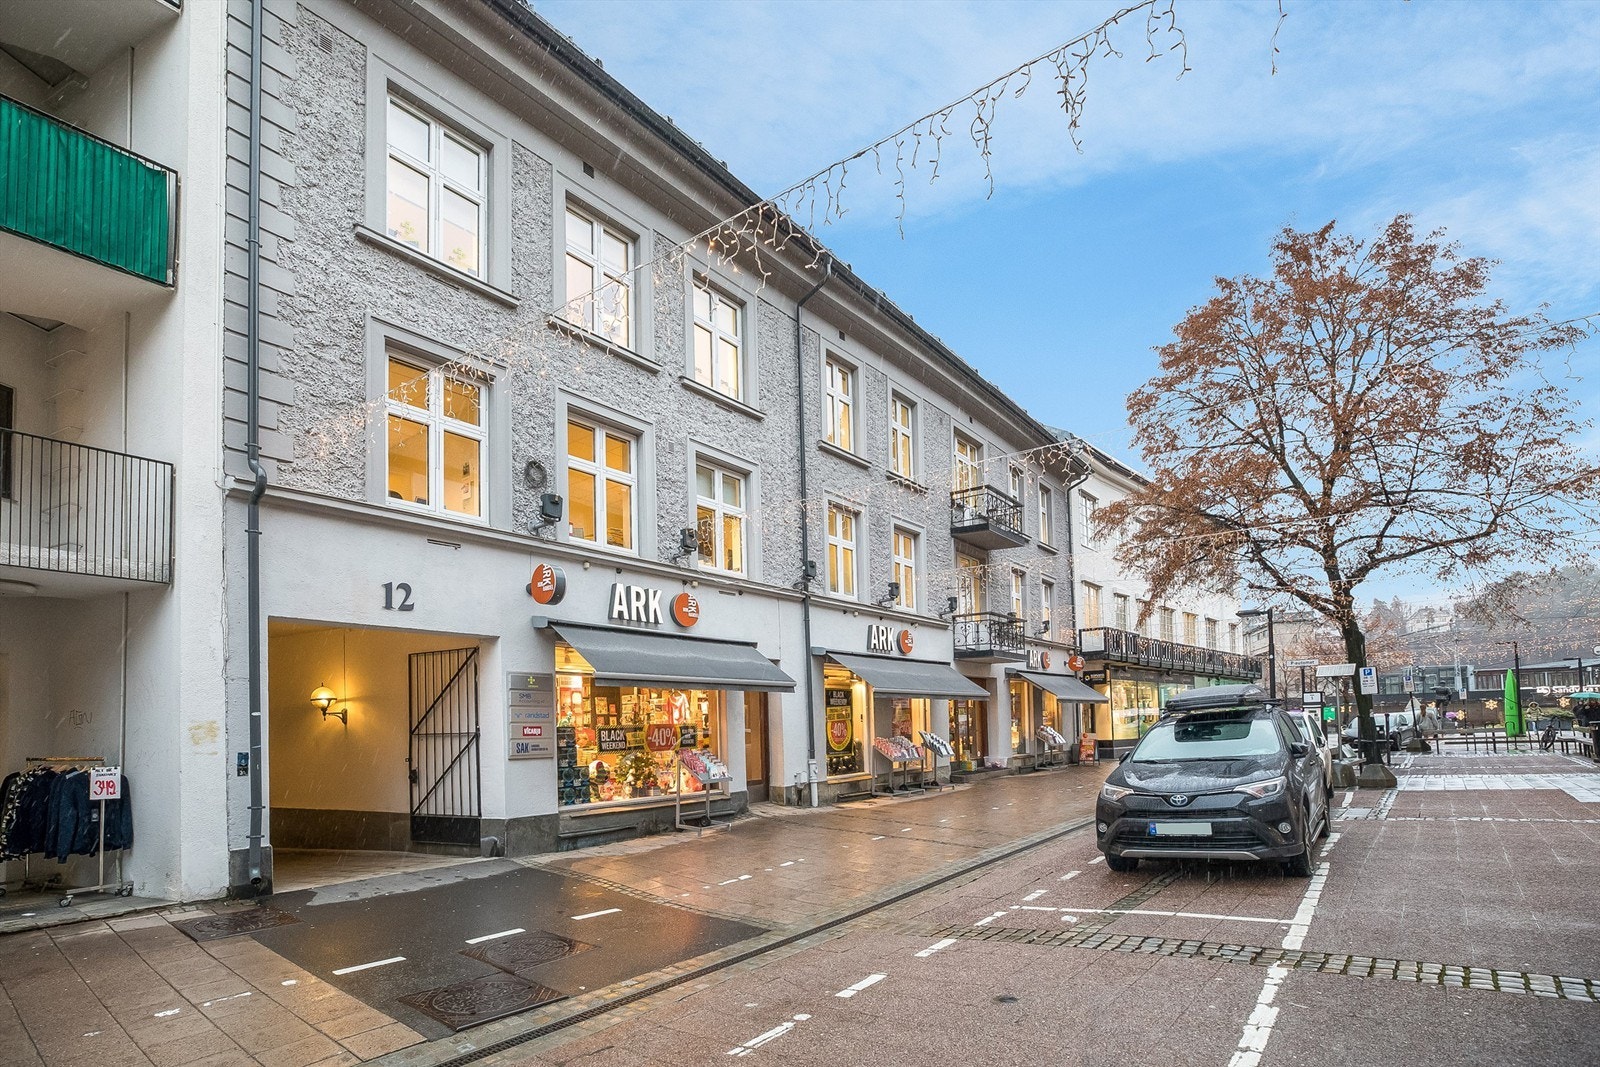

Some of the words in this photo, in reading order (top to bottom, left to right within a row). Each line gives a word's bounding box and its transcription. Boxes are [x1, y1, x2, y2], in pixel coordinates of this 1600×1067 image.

[381, 582, 415, 612] 12
[610, 583, 664, 624] ARK
[870, 624, 895, 651] ARK
[1552, 686, 1594, 694] Sandvka
[601, 730, 626, 741] BLACK
[648, 728, 677, 747] -40%
[516, 743, 530, 754] SAK
[601, 741, 626, 750] WEEKEND
